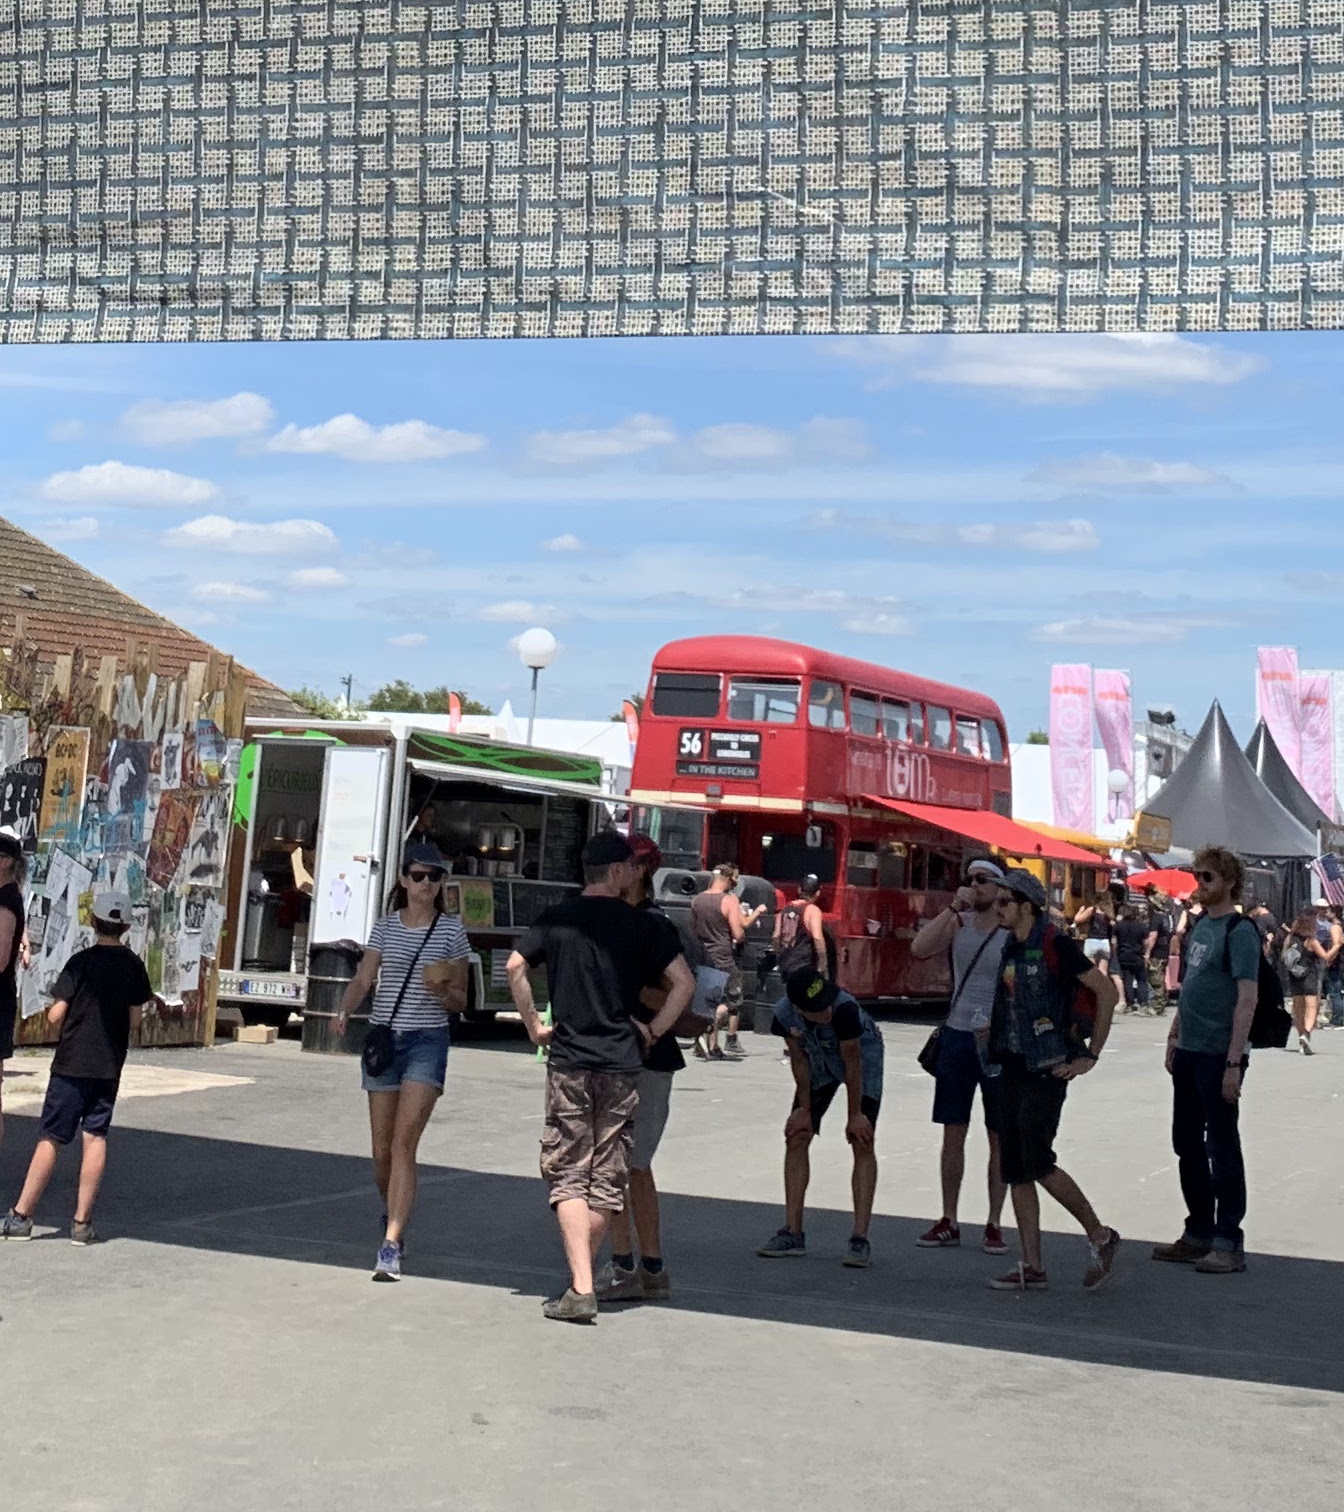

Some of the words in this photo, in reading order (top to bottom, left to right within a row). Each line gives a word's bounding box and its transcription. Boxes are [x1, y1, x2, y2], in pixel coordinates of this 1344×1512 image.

[680, 732, 702, 754] 56
[700, 765, 716, 775] THE
[717, 766, 756, 777] KITCHEN
